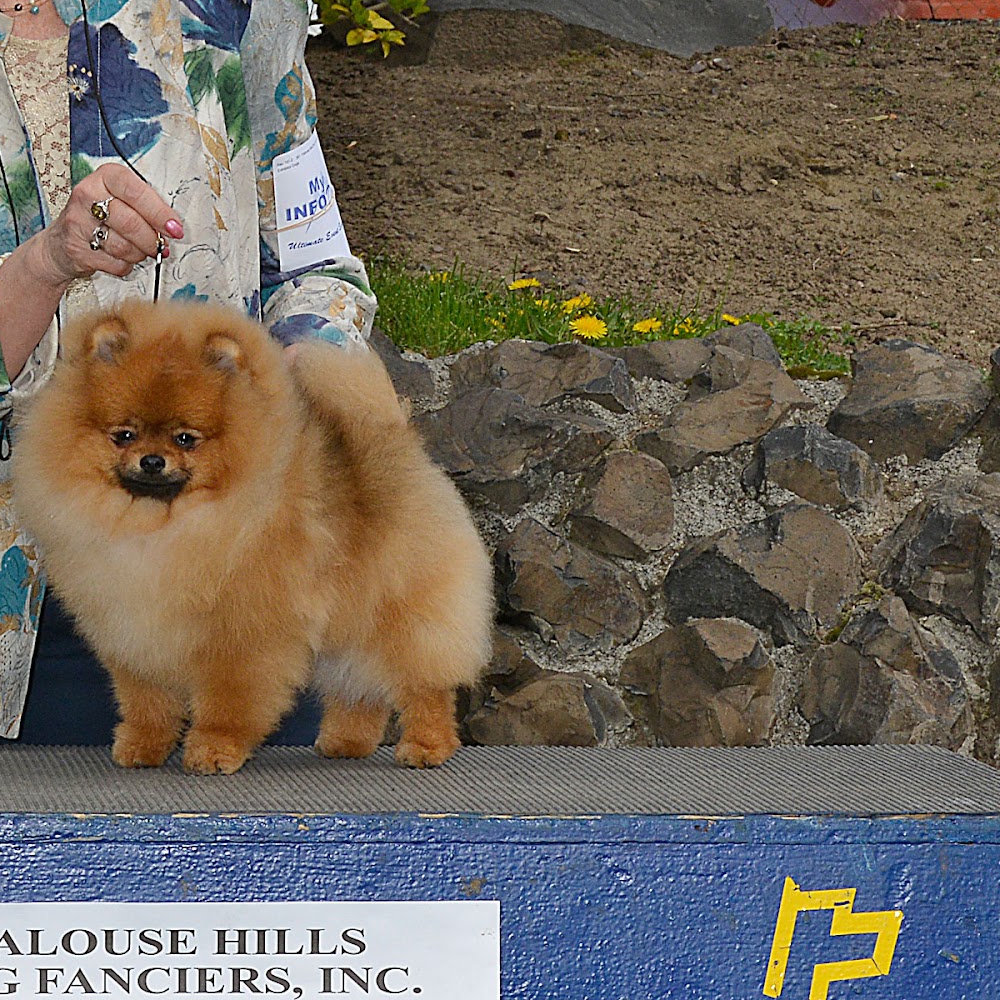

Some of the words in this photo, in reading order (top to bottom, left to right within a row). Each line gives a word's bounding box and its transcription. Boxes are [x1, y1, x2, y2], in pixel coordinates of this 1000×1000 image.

[308, 173, 325, 195] My
[288, 237, 325, 251] Ultimate
[213, 929, 367, 955] HILLS
[35, 967, 303, 999] FANCIERS,
[319, 967, 423, 996] INC.
